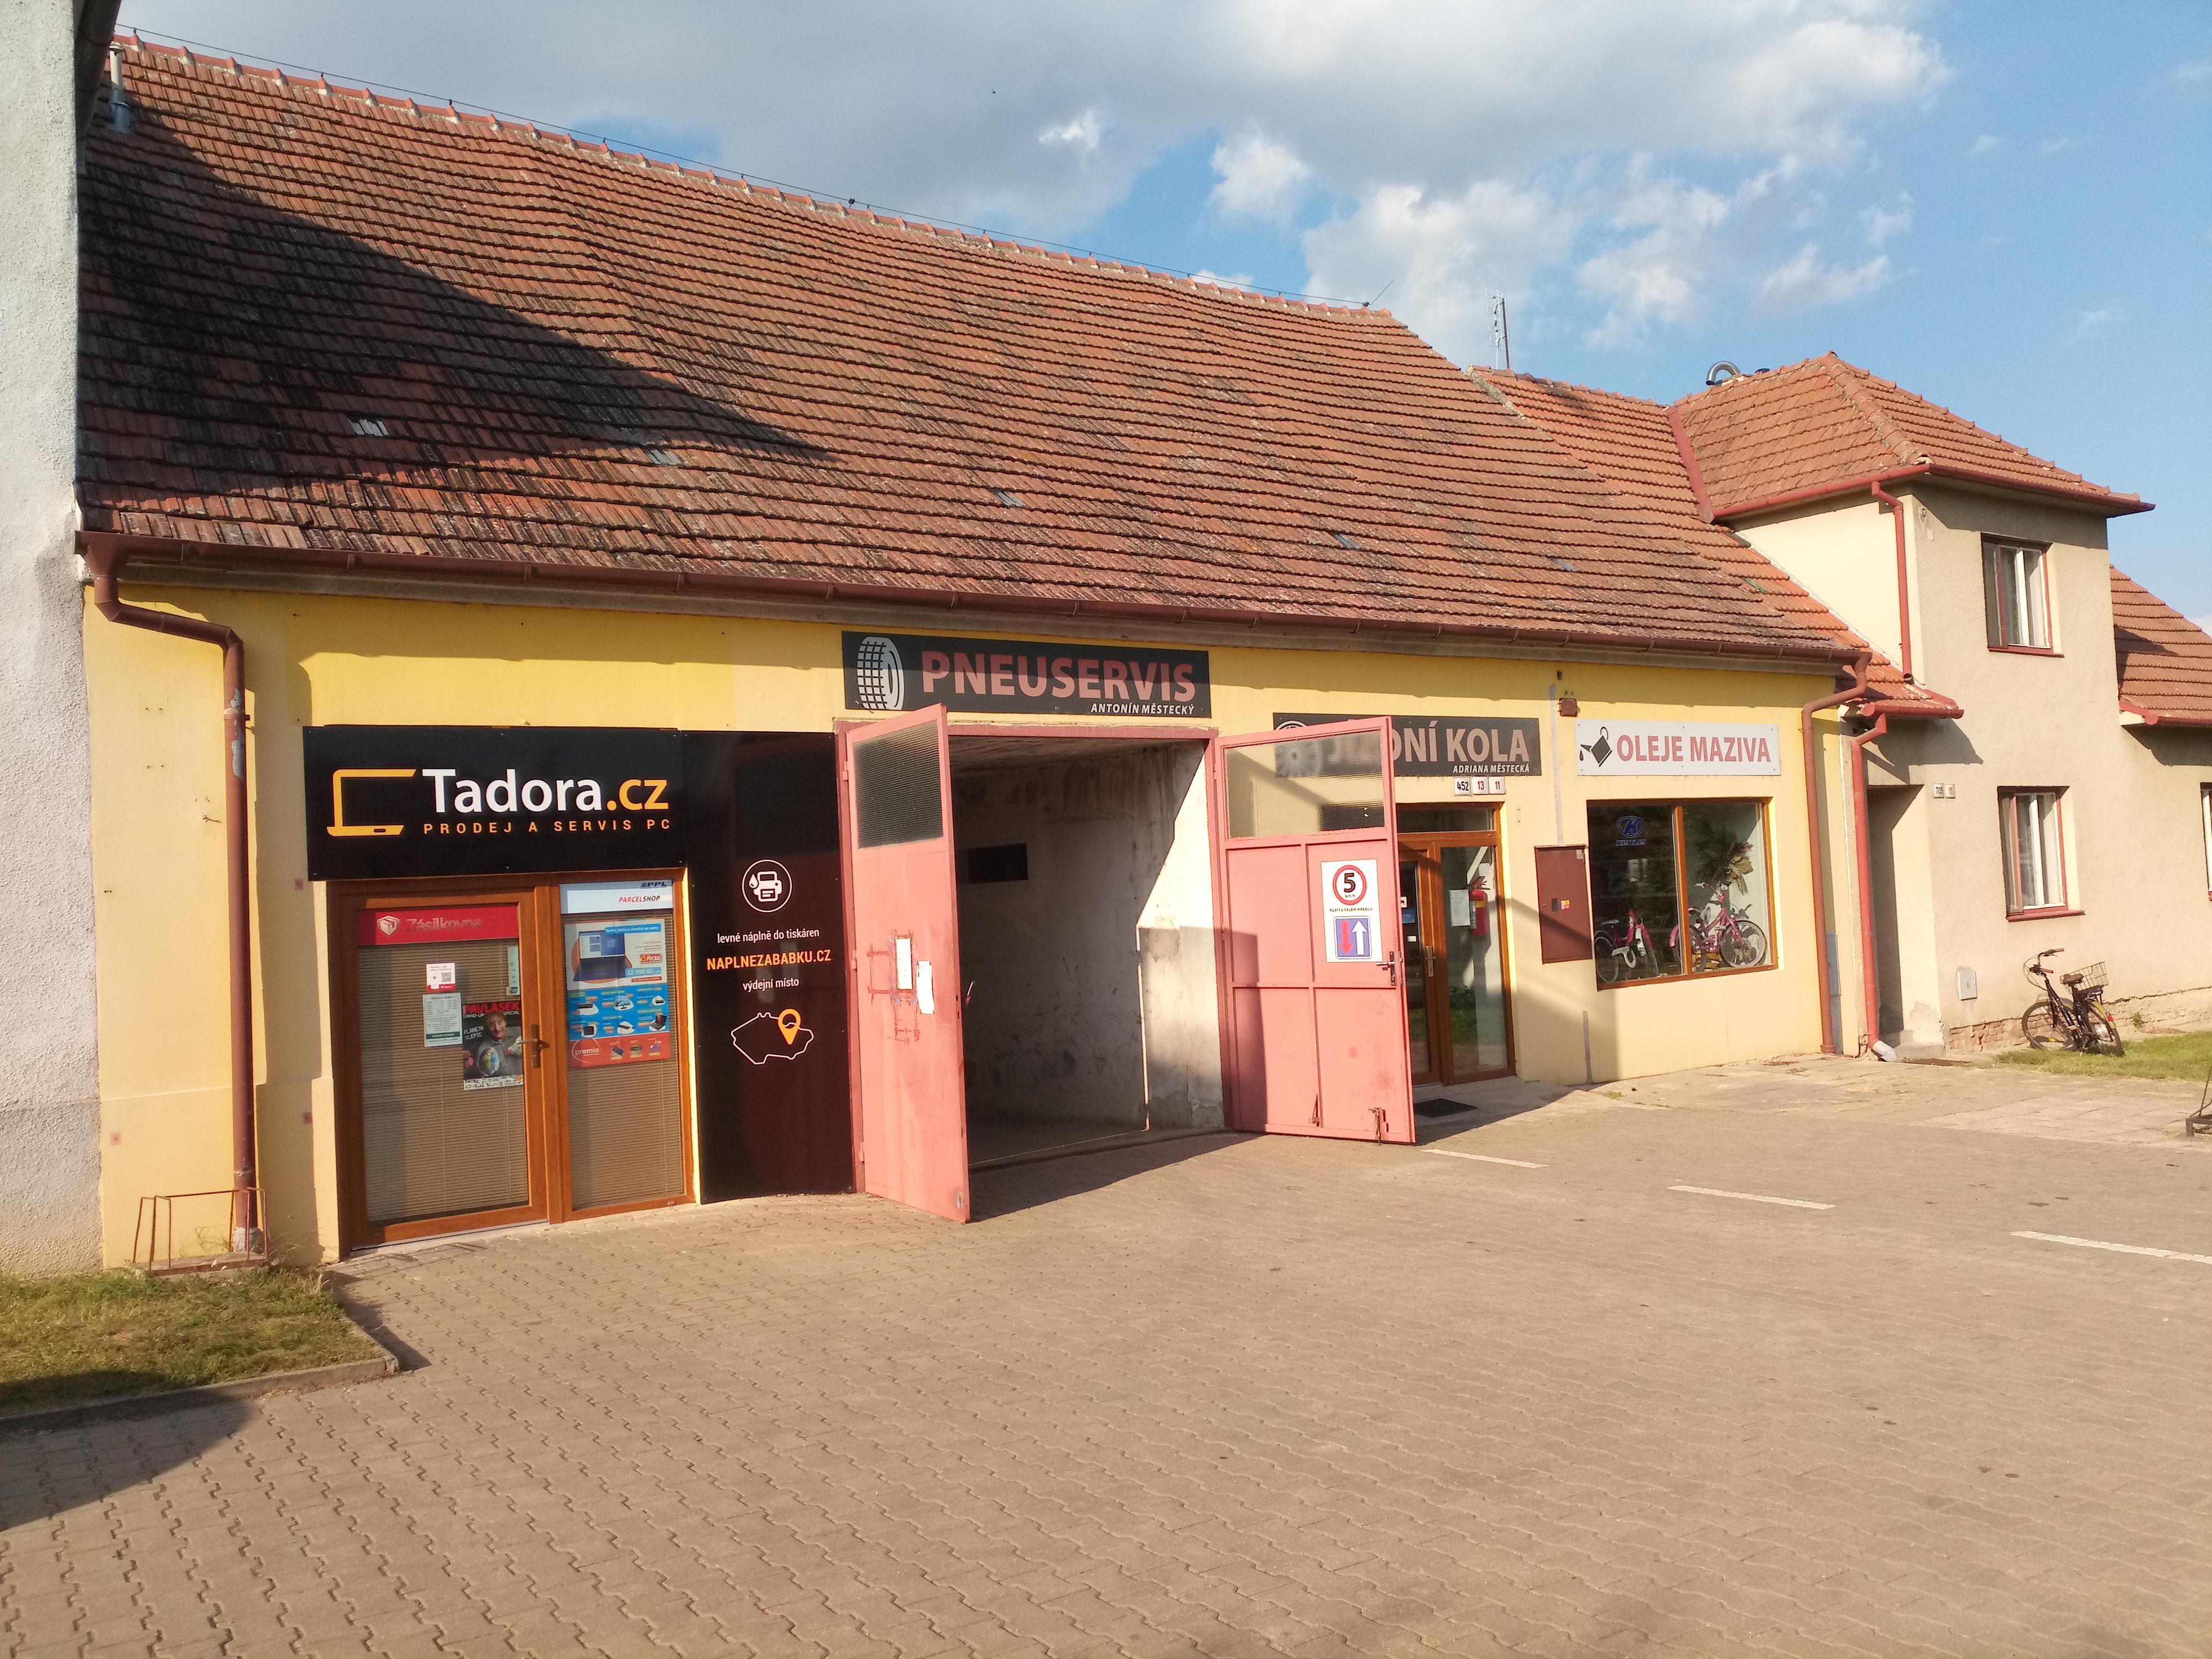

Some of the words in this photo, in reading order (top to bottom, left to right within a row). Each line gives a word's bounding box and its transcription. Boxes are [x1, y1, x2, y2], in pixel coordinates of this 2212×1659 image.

[921, 650, 1196, 702] PNEUSERVIS
[1090, 702, 1139, 713] ANTONÍN
[1141, 702, 1195, 715] MĚSTECKÝ
[1446, 728, 1530, 762] KOLA
[1616, 734, 1684, 761] OLEJE
[1689, 736, 1771, 762] MAZIVA
[1452, 764, 1489, 773] ADRIANA
[1490, 763, 1530, 773] MĚSTECKÁ
[421, 768, 669, 813] Tadora.cz
[1457, 781, 1469, 791] 452
[1477, 780, 1484, 790] 13
[1495, 780, 1500, 790] 11
[424, 822, 512, 834] PRODEJ
[529, 821, 538, 832] A
[554, 819, 632, 831] SERVIS
[646, 818, 670, 830] PC
[1344, 873, 1356, 893] 5
[406, 917, 481, 932] Zásilkovna
[717, 933, 740, 943] levné
[743, 931, 771, 943] náplně
[774, 930, 784, 939] do
[786, 928, 820, 938] tiskáren
[707, 950, 832, 970] NAPLNEZABABKU.CZ
[743, 979, 774, 993] výdejní
[775, 978, 800, 988] místo
[463, 1025, 484, 1035] PLANETA
[575, 1047, 599, 1056] premio
